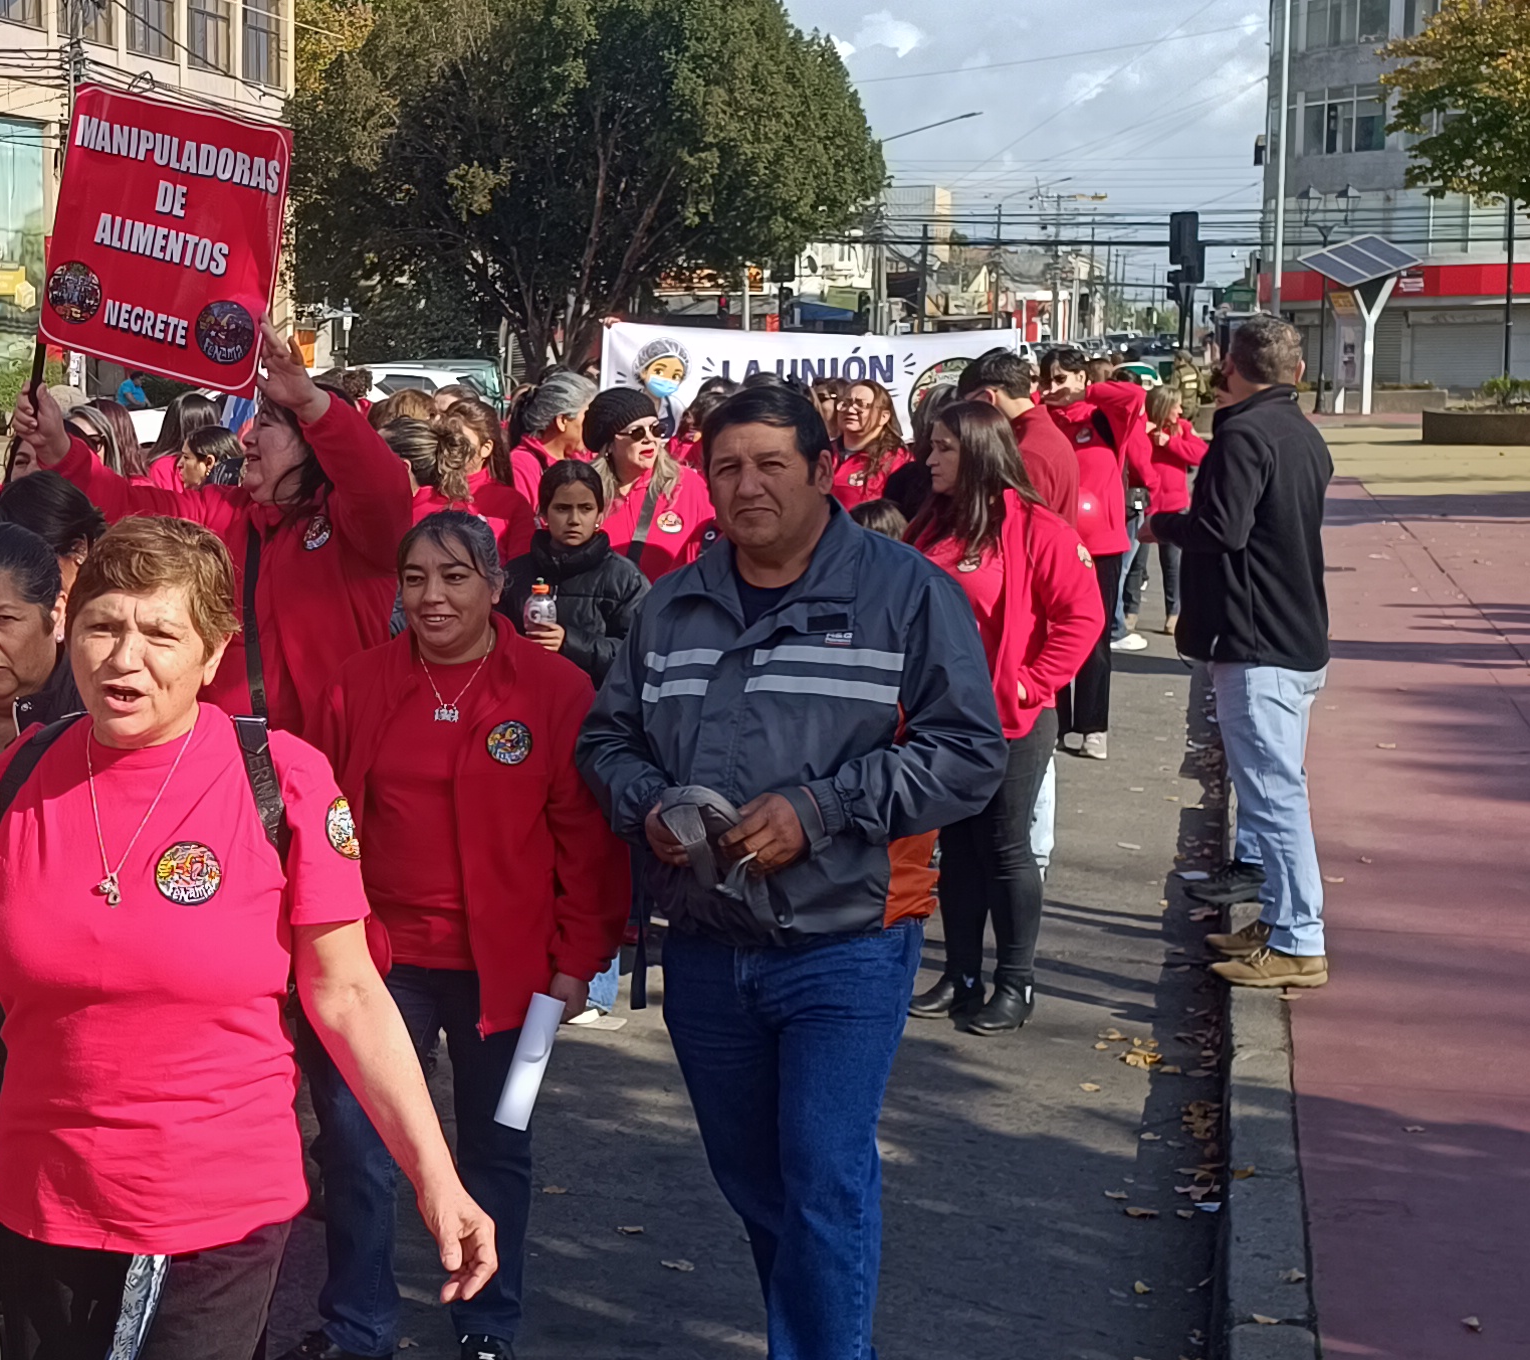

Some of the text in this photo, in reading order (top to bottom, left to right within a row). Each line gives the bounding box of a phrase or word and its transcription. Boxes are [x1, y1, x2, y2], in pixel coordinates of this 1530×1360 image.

[74, 114, 281, 194] MANIPULADORAS
[155, 180, 187, 217] DE
[94, 213, 229, 276] ALIMENTOS
[103, 298, 188, 346] NEGRETE
[776, 346, 894, 384] UNIÓN
